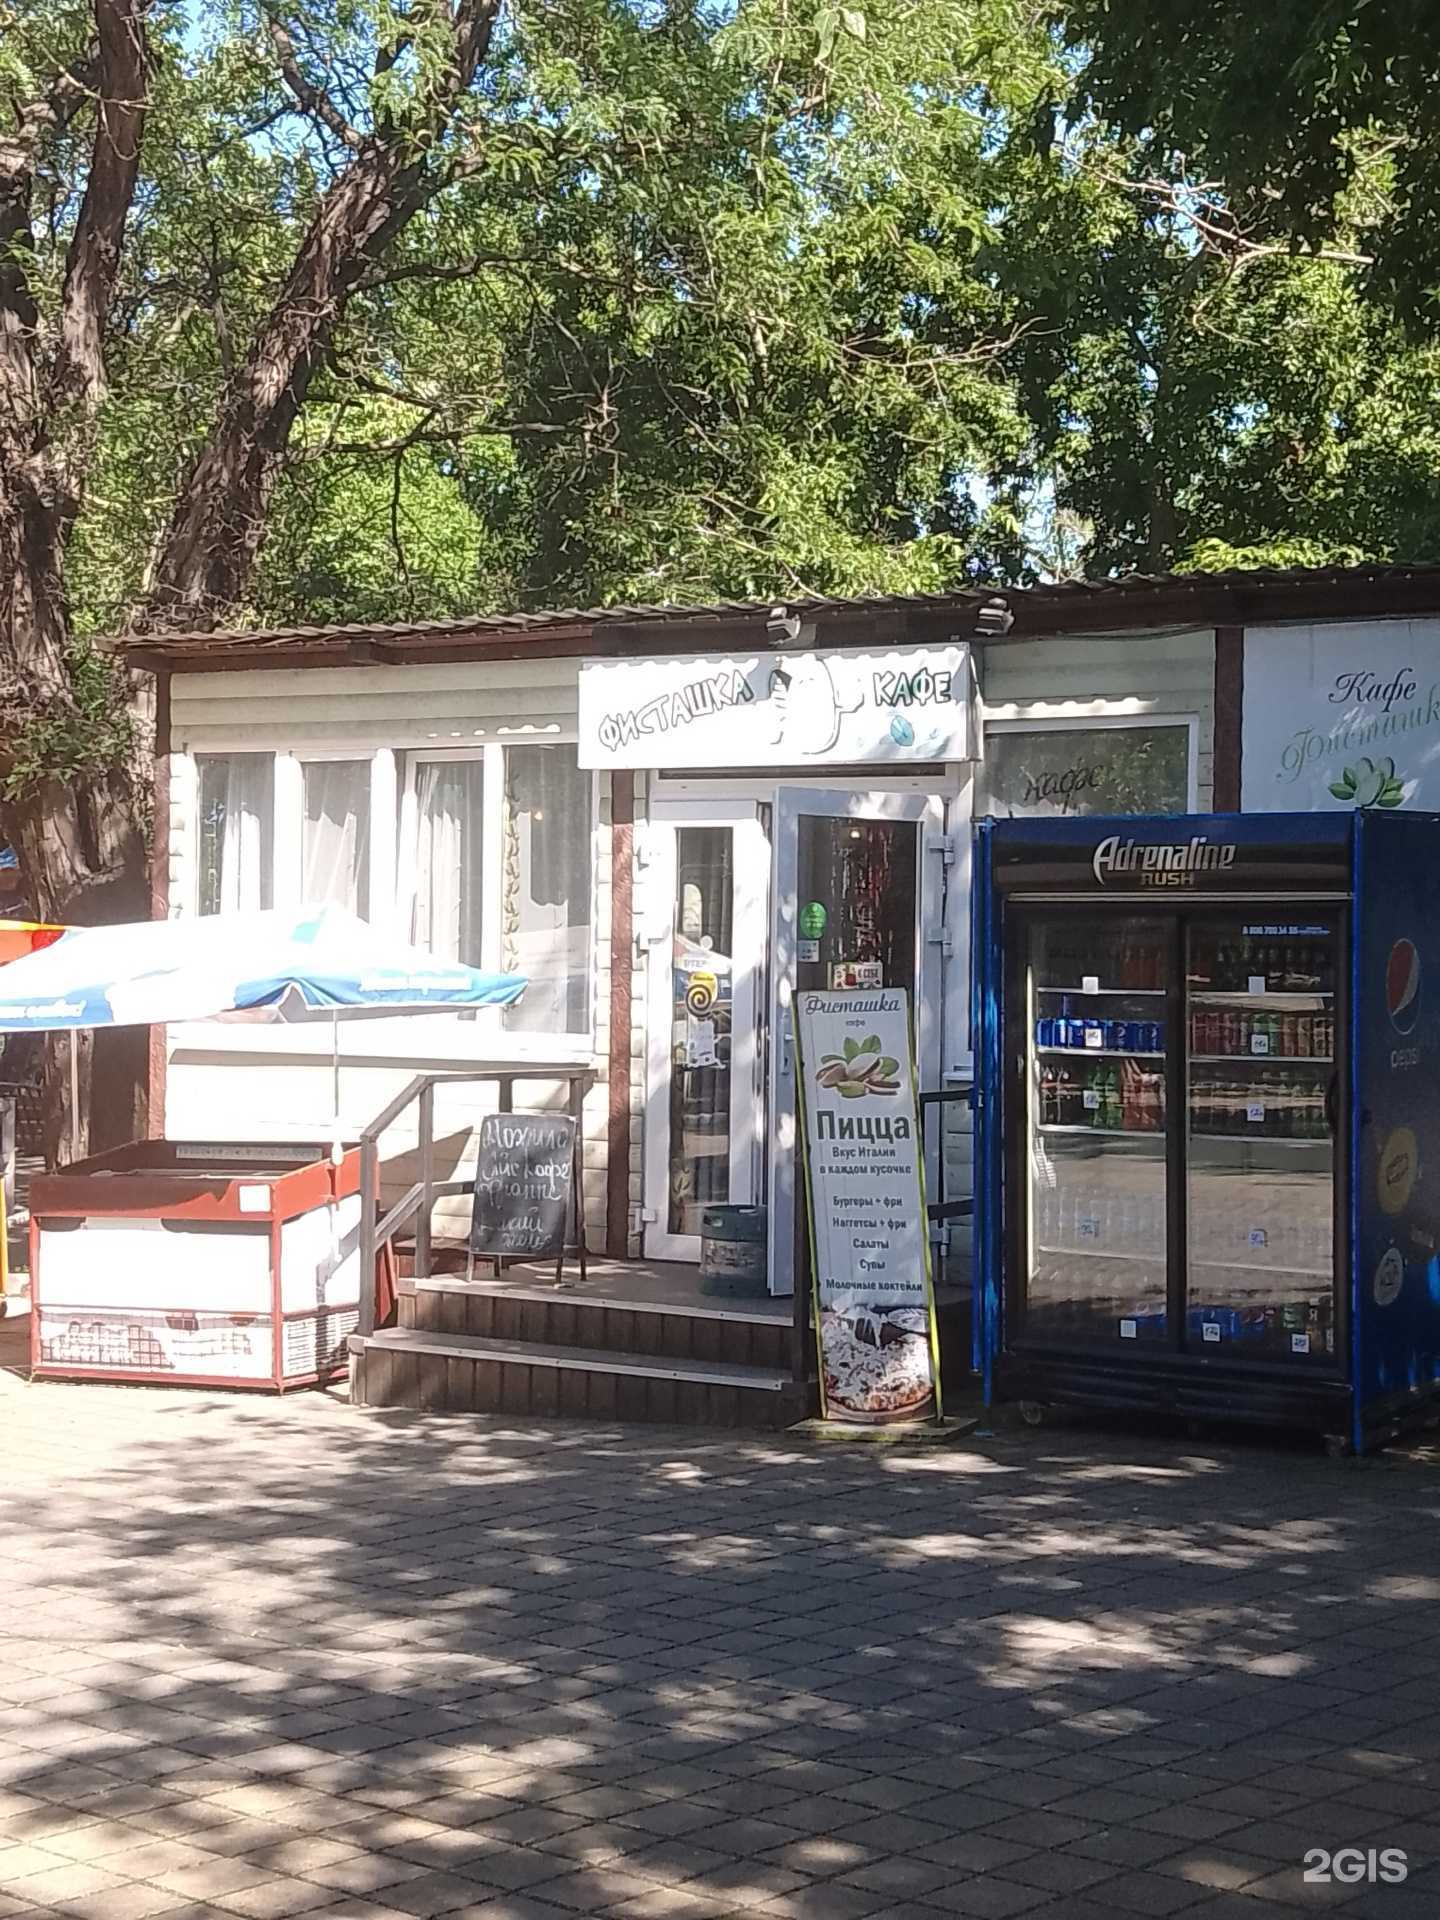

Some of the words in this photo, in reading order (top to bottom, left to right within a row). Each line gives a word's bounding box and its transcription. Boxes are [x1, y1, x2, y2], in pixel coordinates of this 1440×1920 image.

[873, 667, 952, 707] КАФЕ
[1327, 667, 1417, 713] Кафе
[598, 669, 754, 752] ФИСТАШКА
[1093, 835, 1236, 886] Adrenaline
[1141, 872, 1195, 886] RUSH
[806, 993, 901, 1015] Фисташка
[817, 1110, 911, 1145] Пицца
[832, 1146, 856, 1160] Вкус
[859, 1146, 896, 1157] Италии
[820, 1166, 826, 1174] в
[828, 1166, 868, 1176] каждом
[870, 1166, 911, 1176] кусочке
[833, 1196, 873, 1208] Бургеры
[883, 1196, 903, 1208] фри
[832, 1217, 877, 1228] Наггетсы
[887, 1218, 907, 1231] фри
[852, 1238, 889, 1249] Салаты
[860, 1258, 886, 1272] Супы
[826, 1279, 877, 1289] Молочные
[878, 1280, 922, 1291] коктейли
